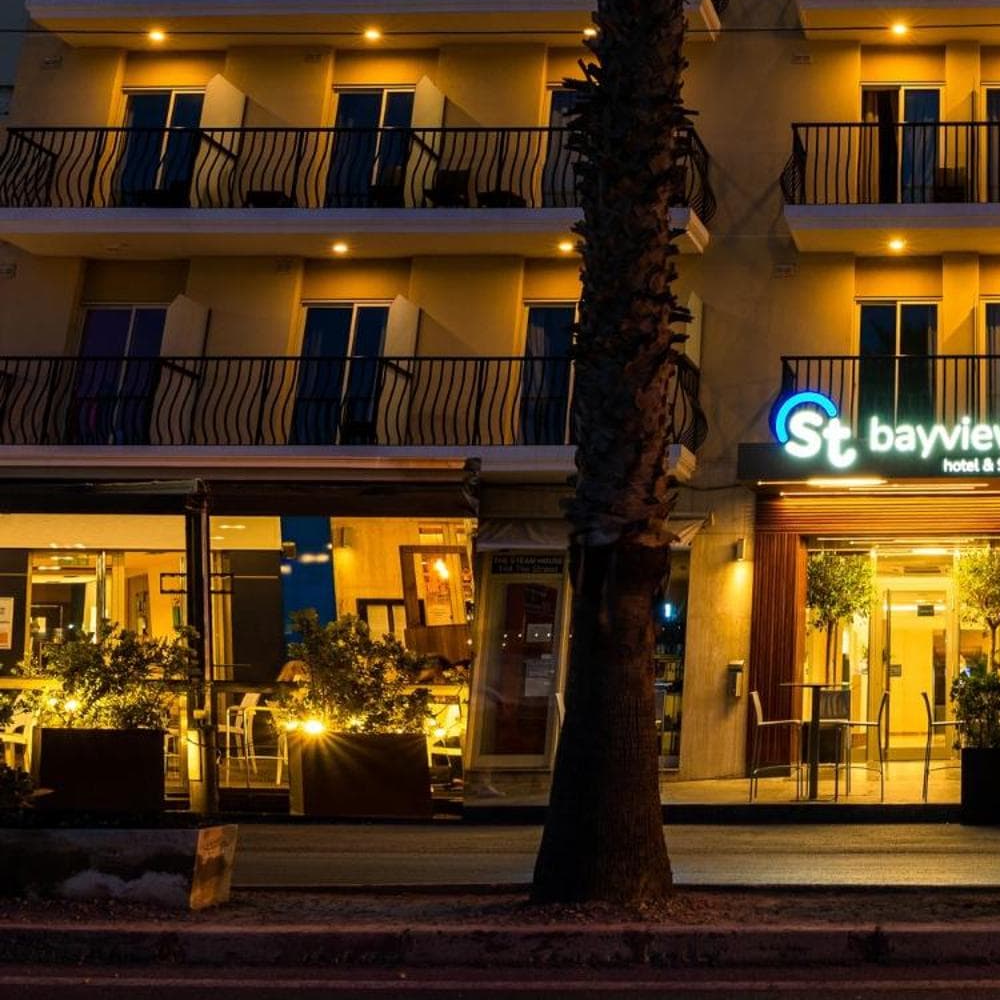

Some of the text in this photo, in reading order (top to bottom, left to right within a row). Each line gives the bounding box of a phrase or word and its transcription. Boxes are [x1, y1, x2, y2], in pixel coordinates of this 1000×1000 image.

[784, 409, 857, 468] St
[943, 457, 980, 472] hotel
[982, 457, 994, 472] &
